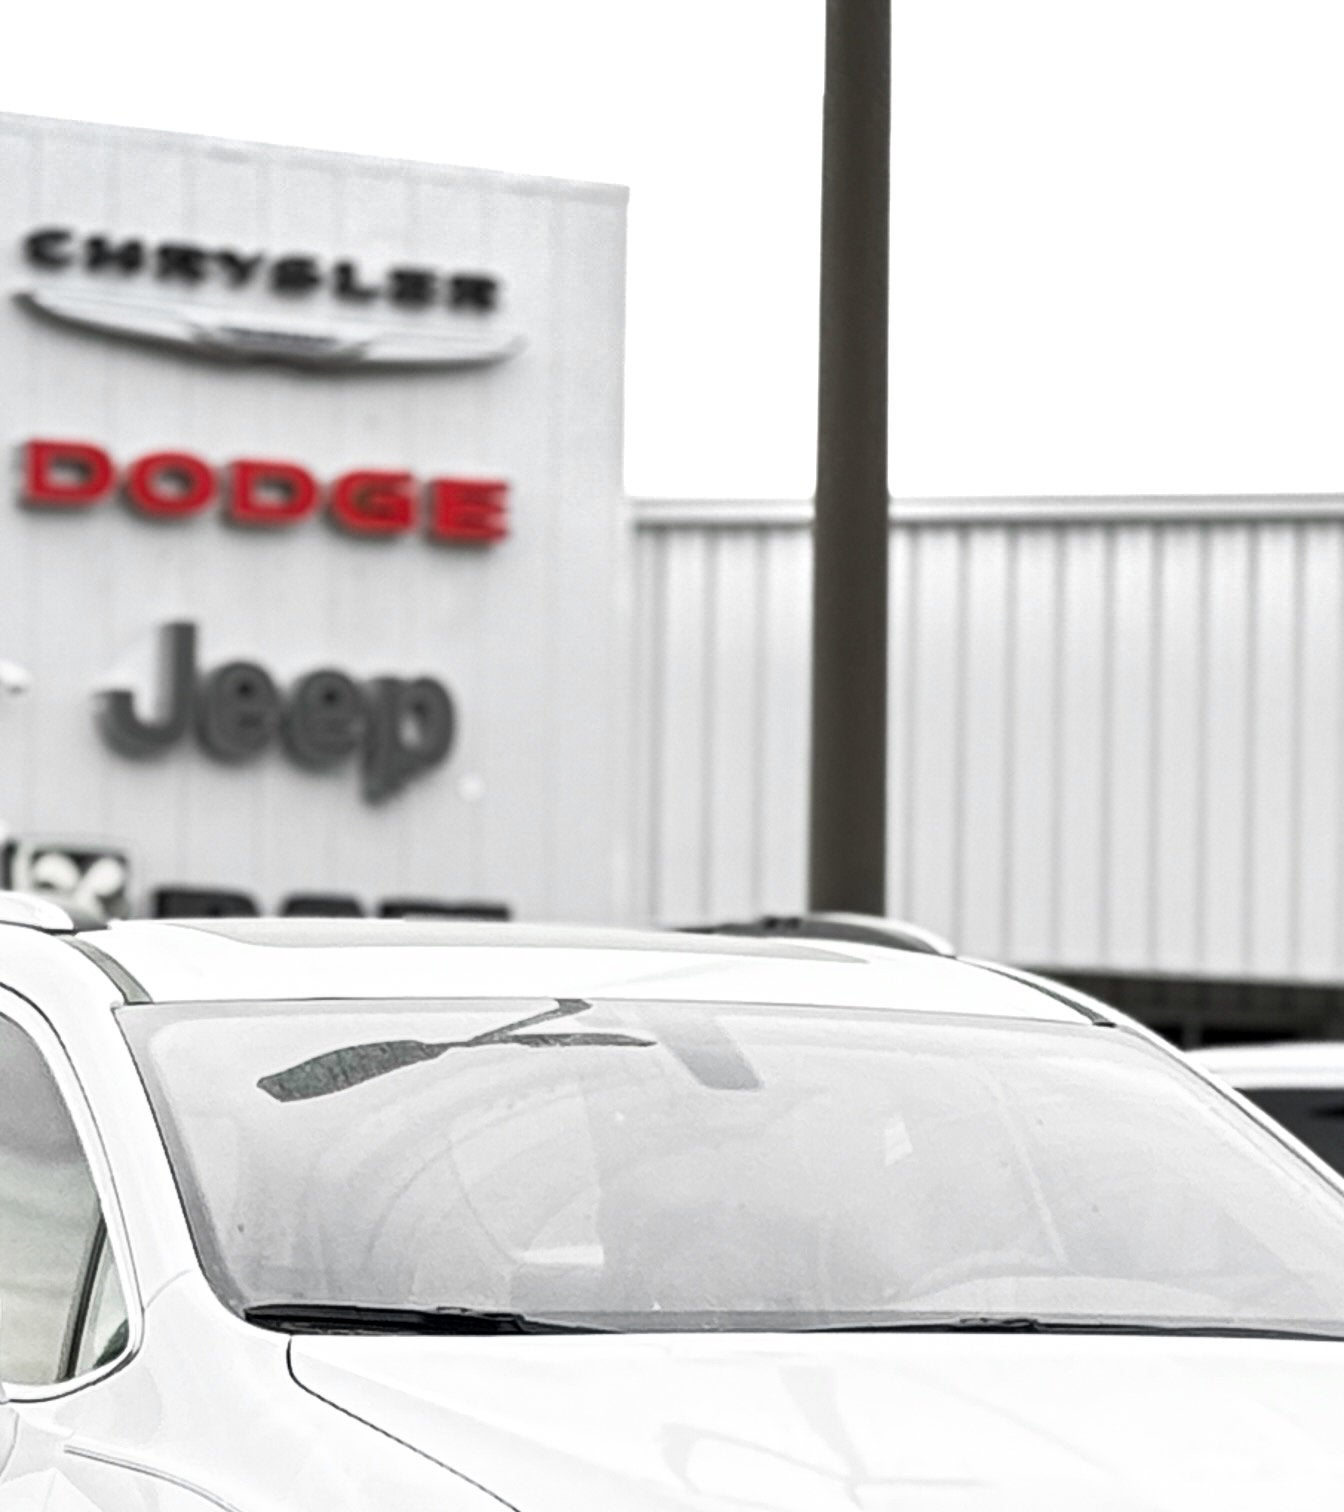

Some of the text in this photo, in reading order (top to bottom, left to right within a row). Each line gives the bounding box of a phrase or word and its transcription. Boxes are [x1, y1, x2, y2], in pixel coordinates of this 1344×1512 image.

[22, 227, 499, 312] CHRYSLER
[18, 438, 512, 548] DODGE
[94, 619, 457, 807] Jeep
